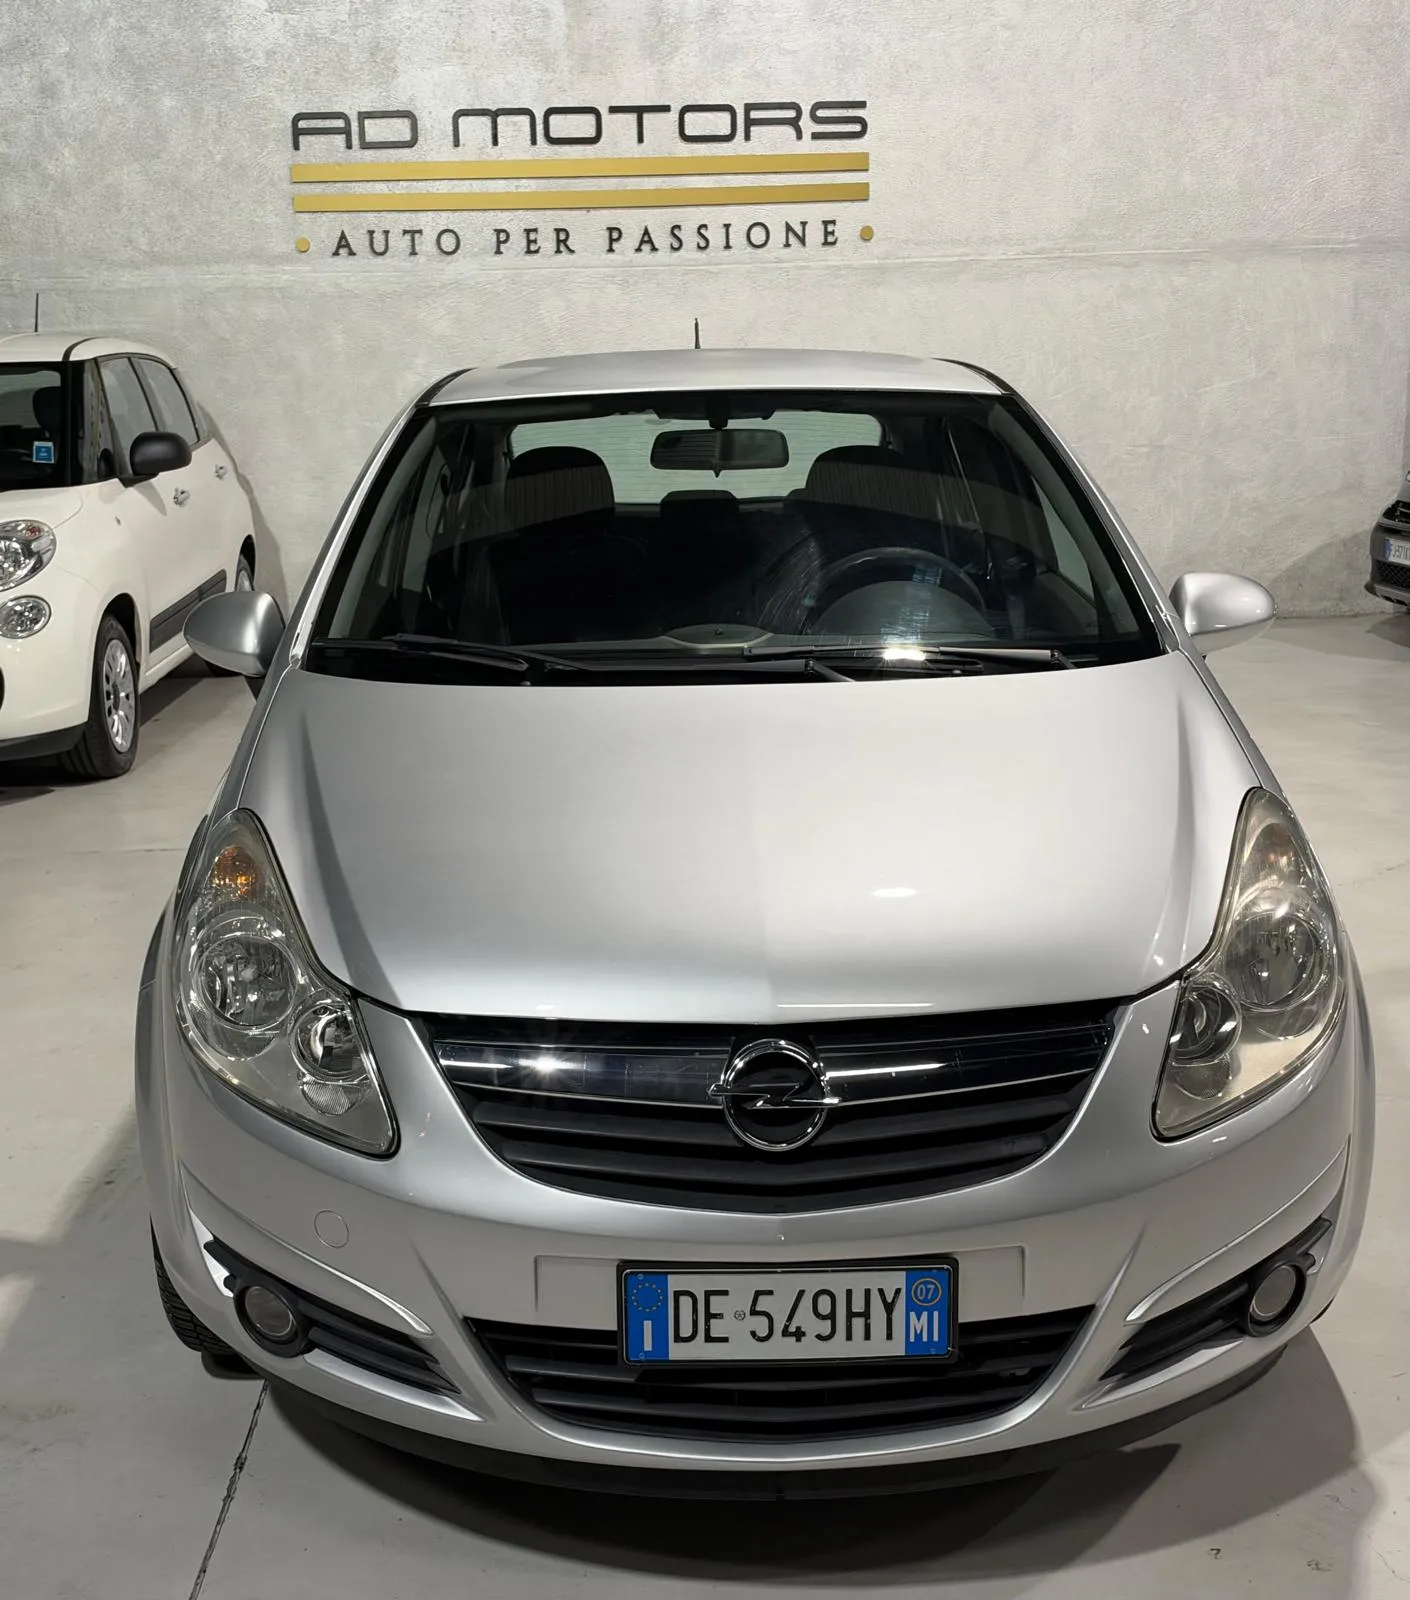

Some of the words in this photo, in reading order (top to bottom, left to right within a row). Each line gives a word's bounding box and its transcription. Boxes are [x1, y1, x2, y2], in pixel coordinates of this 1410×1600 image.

[292, 110, 418, 151] AD
[452, 101, 869, 148] MOTORS
[332, 229, 461, 257] AUTO
[493, 228, 576, 255] PER
[606, 219, 839, 253] PASSIONE
[916, 1282, 935, 1301] 07
[672, 1289, 730, 1344] DE
[749, 1287, 903, 1343] 549HY
[908, 1310, 940, 1343] MI
